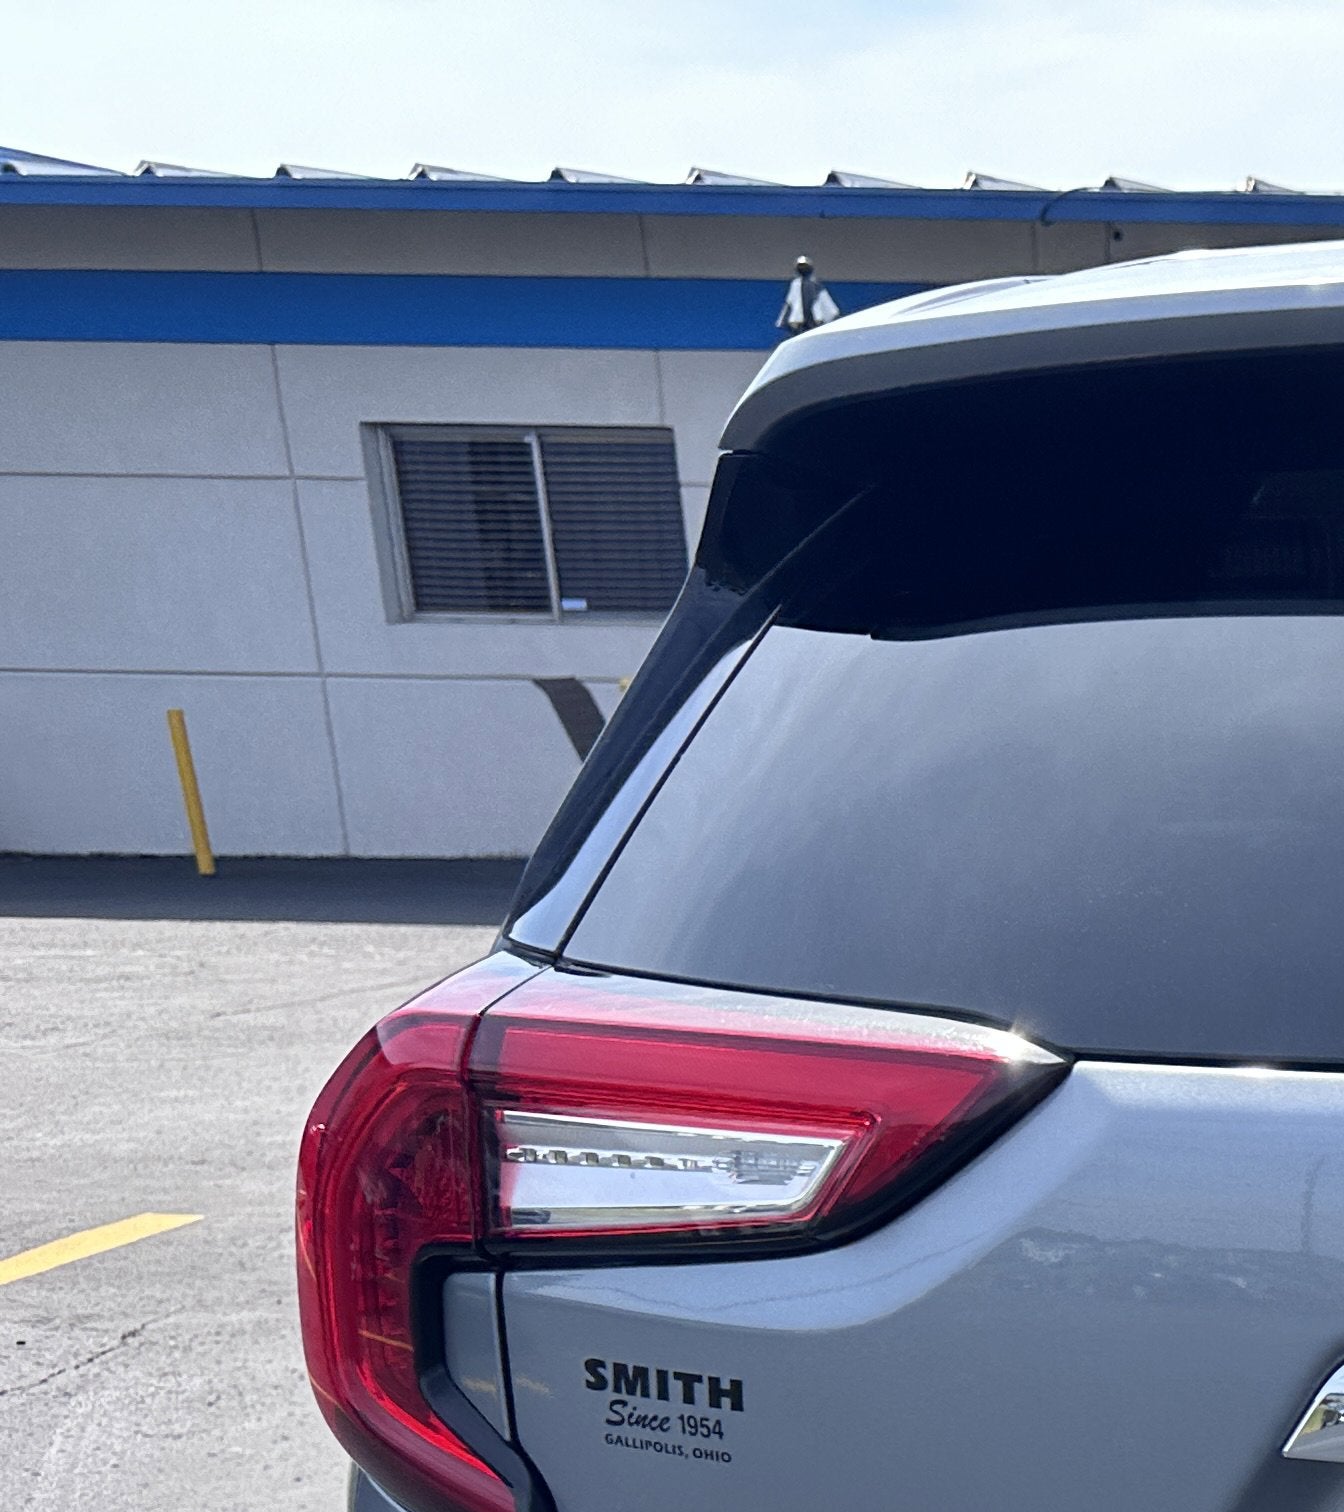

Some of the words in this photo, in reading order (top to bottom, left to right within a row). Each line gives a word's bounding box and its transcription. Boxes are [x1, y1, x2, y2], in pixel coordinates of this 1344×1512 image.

[584, 1358, 744, 1412] SMITH
[605, 1399, 671, 1432] Since
[678, 1414, 724, 1439] 1954
[604, 1433, 687, 1459] GALLIPOLIS,
[692, 1448, 732, 1463] OHIO
